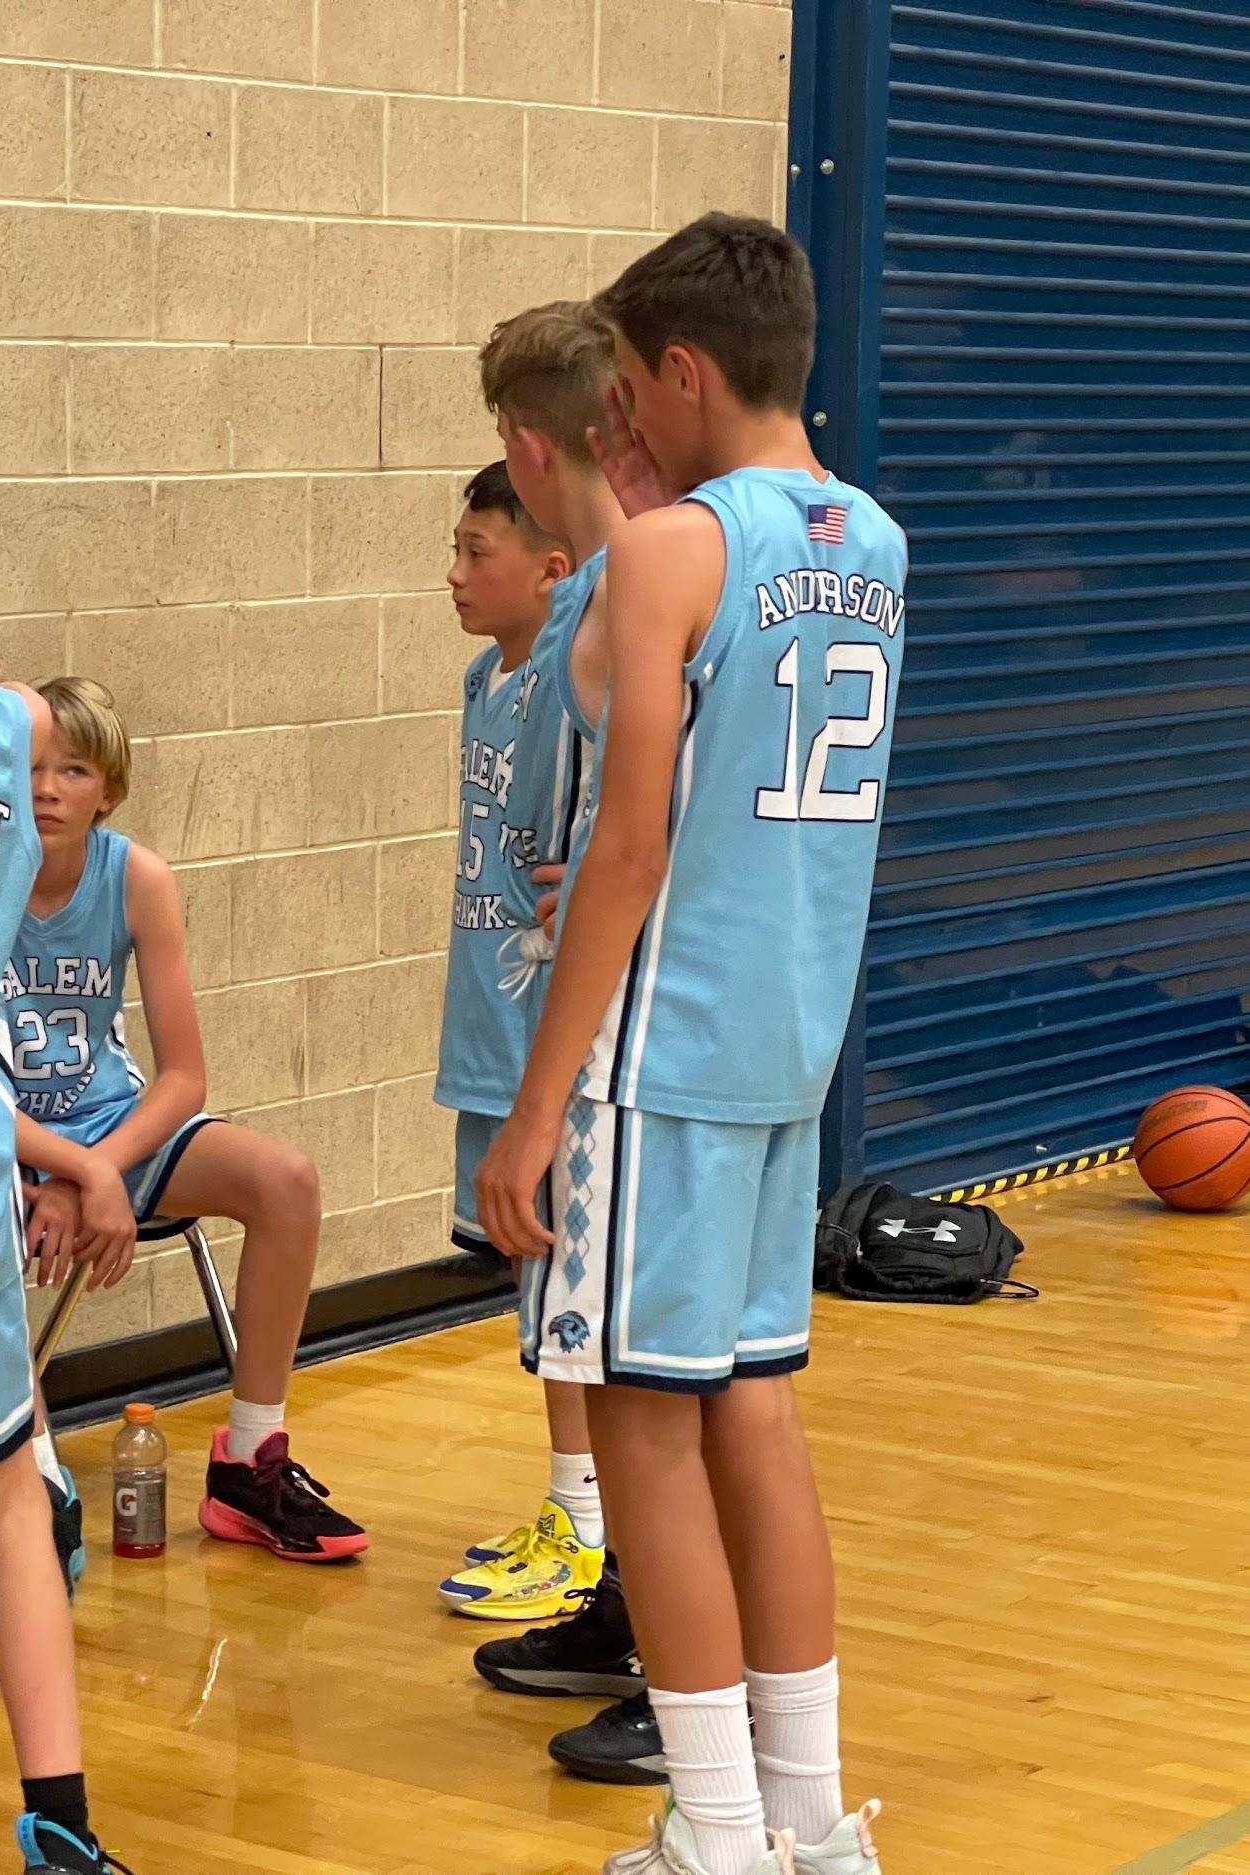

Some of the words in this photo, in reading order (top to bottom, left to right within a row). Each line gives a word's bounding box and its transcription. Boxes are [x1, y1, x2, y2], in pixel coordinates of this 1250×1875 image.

[754, 637, 889, 822] 12
[13, 1007, 90, 1080] 23
[116, 1488, 138, 1516] G
